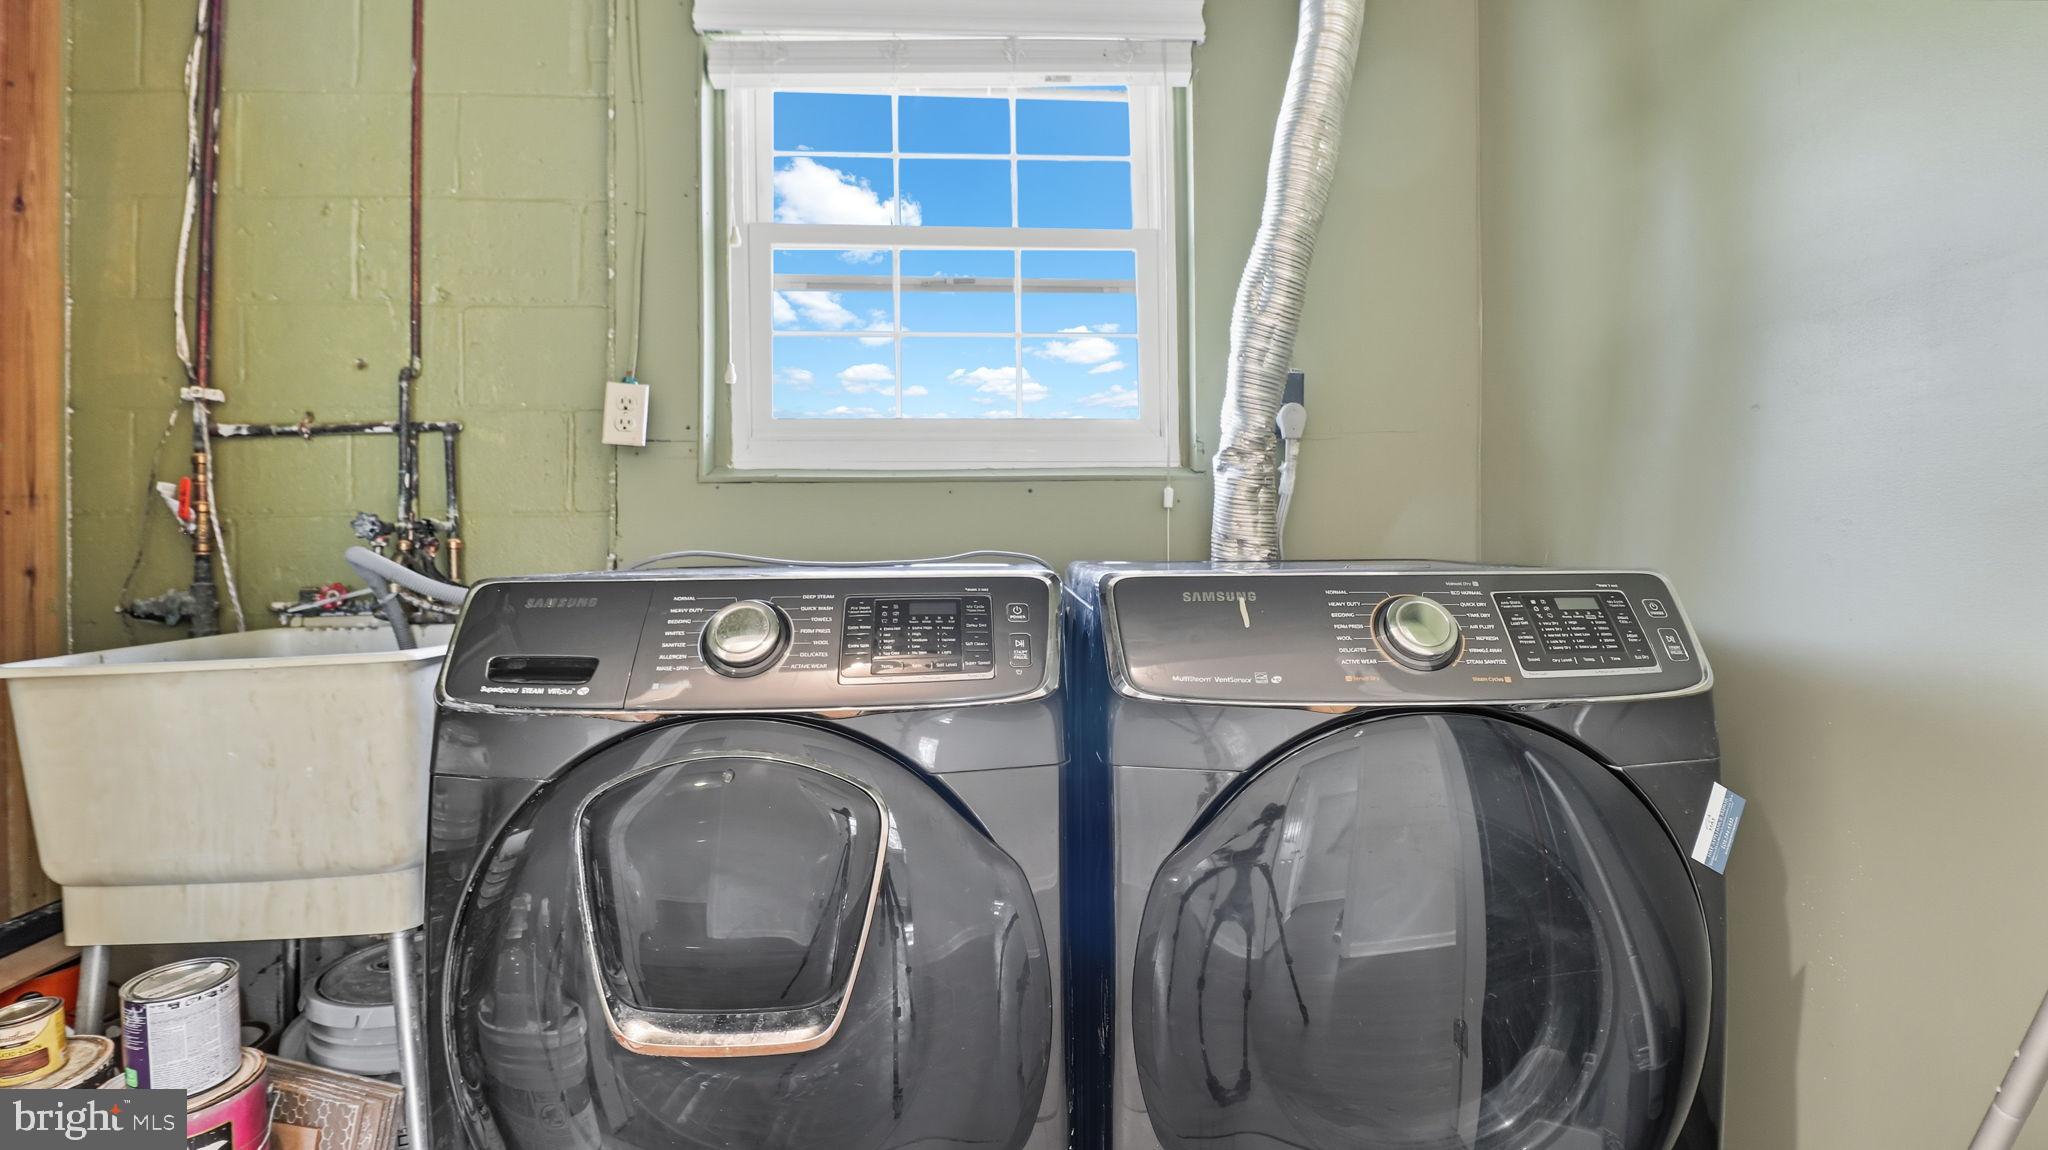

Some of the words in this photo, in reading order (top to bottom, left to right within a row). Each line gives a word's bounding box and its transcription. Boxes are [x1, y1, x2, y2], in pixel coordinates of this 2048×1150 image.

[1182, 591, 1257, 602] SAMSUNG
[524, 597, 598, 609] SAMSUNG
[1214, 676, 1252, 684] VentSensor
